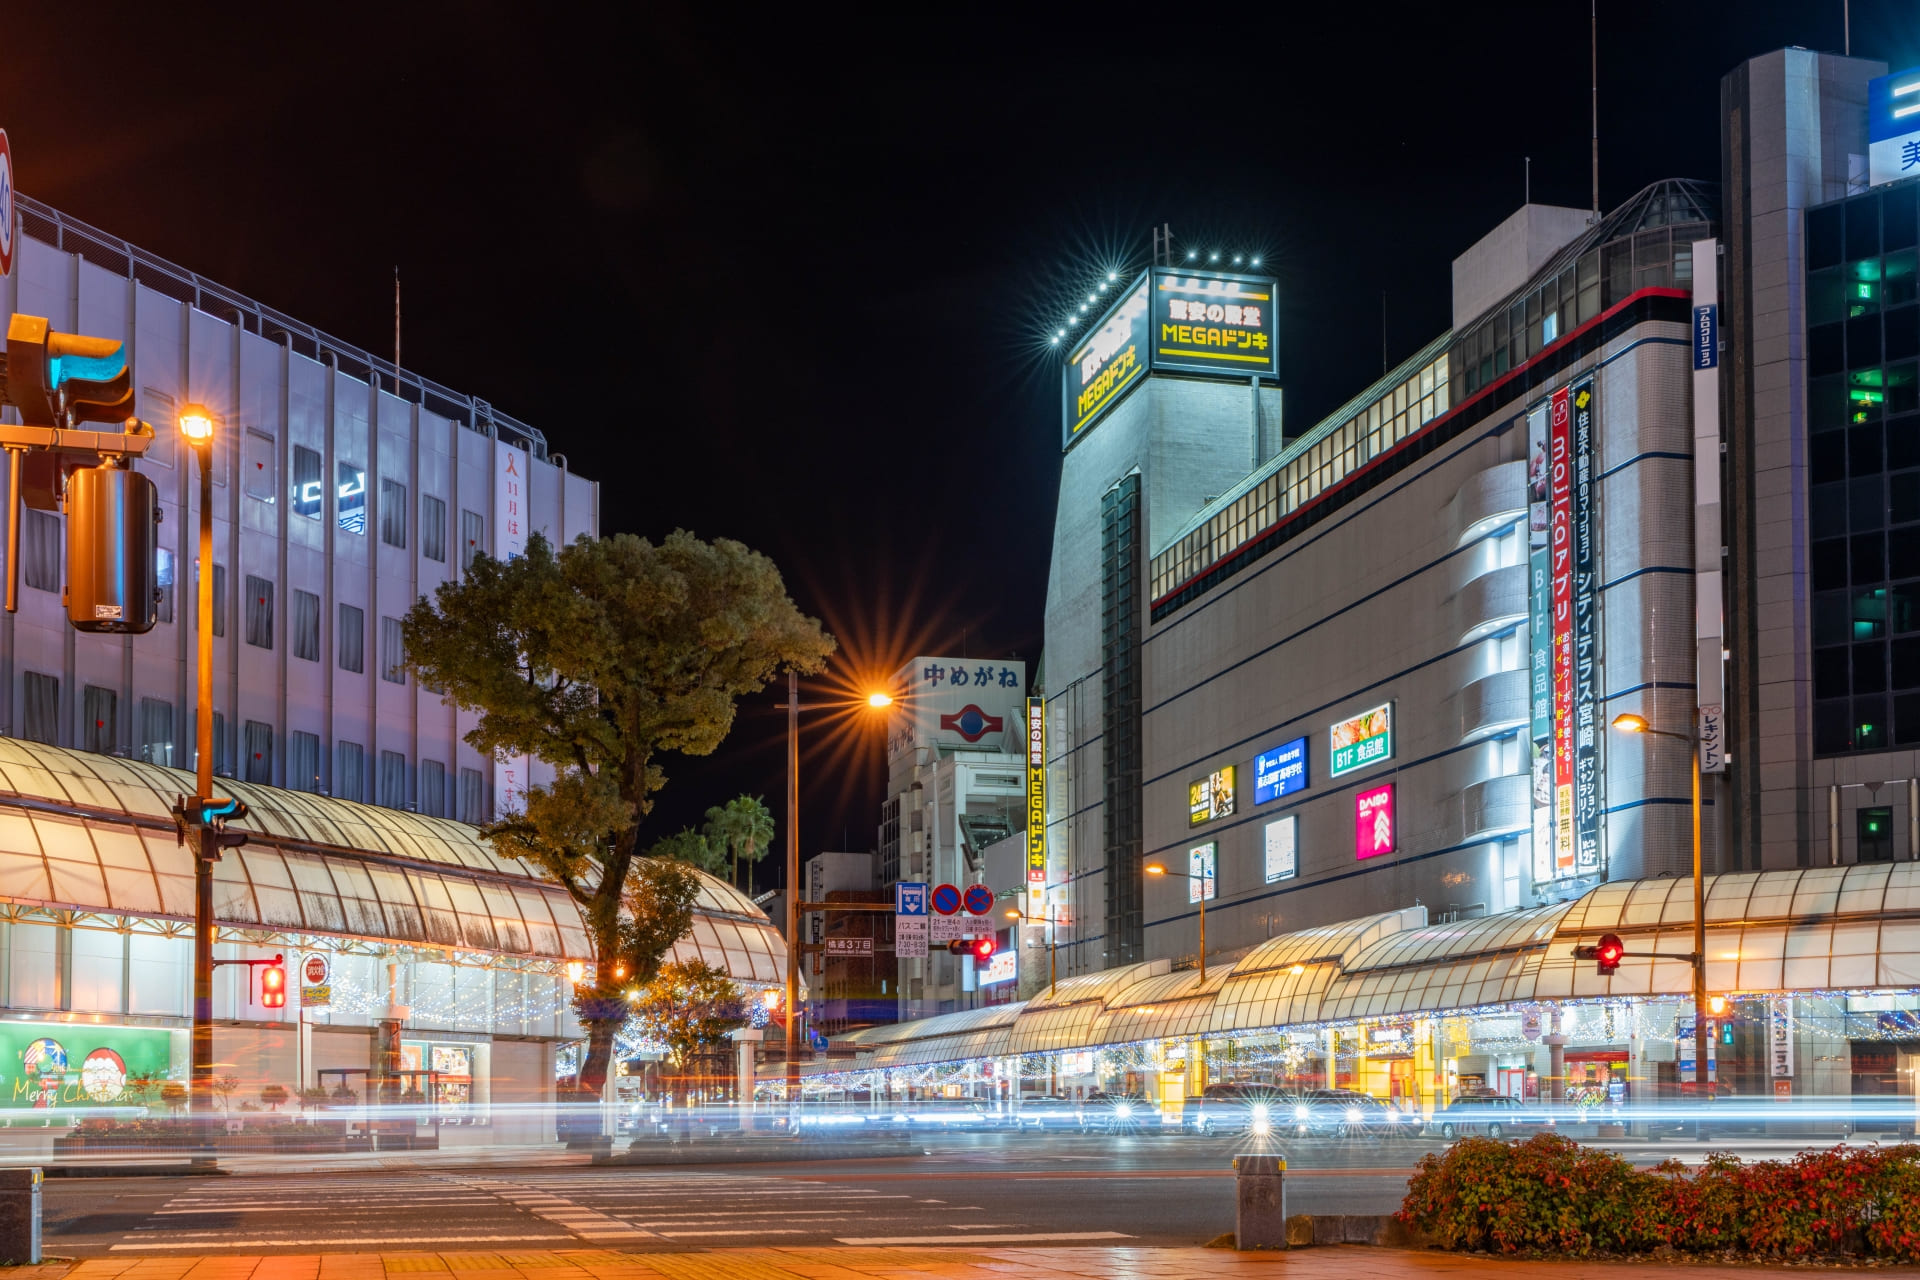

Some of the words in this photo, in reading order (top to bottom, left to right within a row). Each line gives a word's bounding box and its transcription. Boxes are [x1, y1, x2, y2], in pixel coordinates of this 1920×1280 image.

[1162, 324, 1268, 350] MEGAドンキ
[1078, 345, 1136, 418] MEGAドンキ
[924, 663, 1019, 688] 中めがね
[1578, 571, 1594, 748] シティテラス宮崎
[1533, 648, 1547, 720] 食品館
[1336, 748, 1353, 769] B1F
[1357, 737, 1385, 762] 食品館
[1704, 715, 1719, 770] レキシントン
[1273, 782, 1285, 797] 7F
[1359, 792, 1388, 812] DAISO
[1030, 767, 1043, 867] MEGAドンキ
[12, 1077, 57, 1109] Merry
